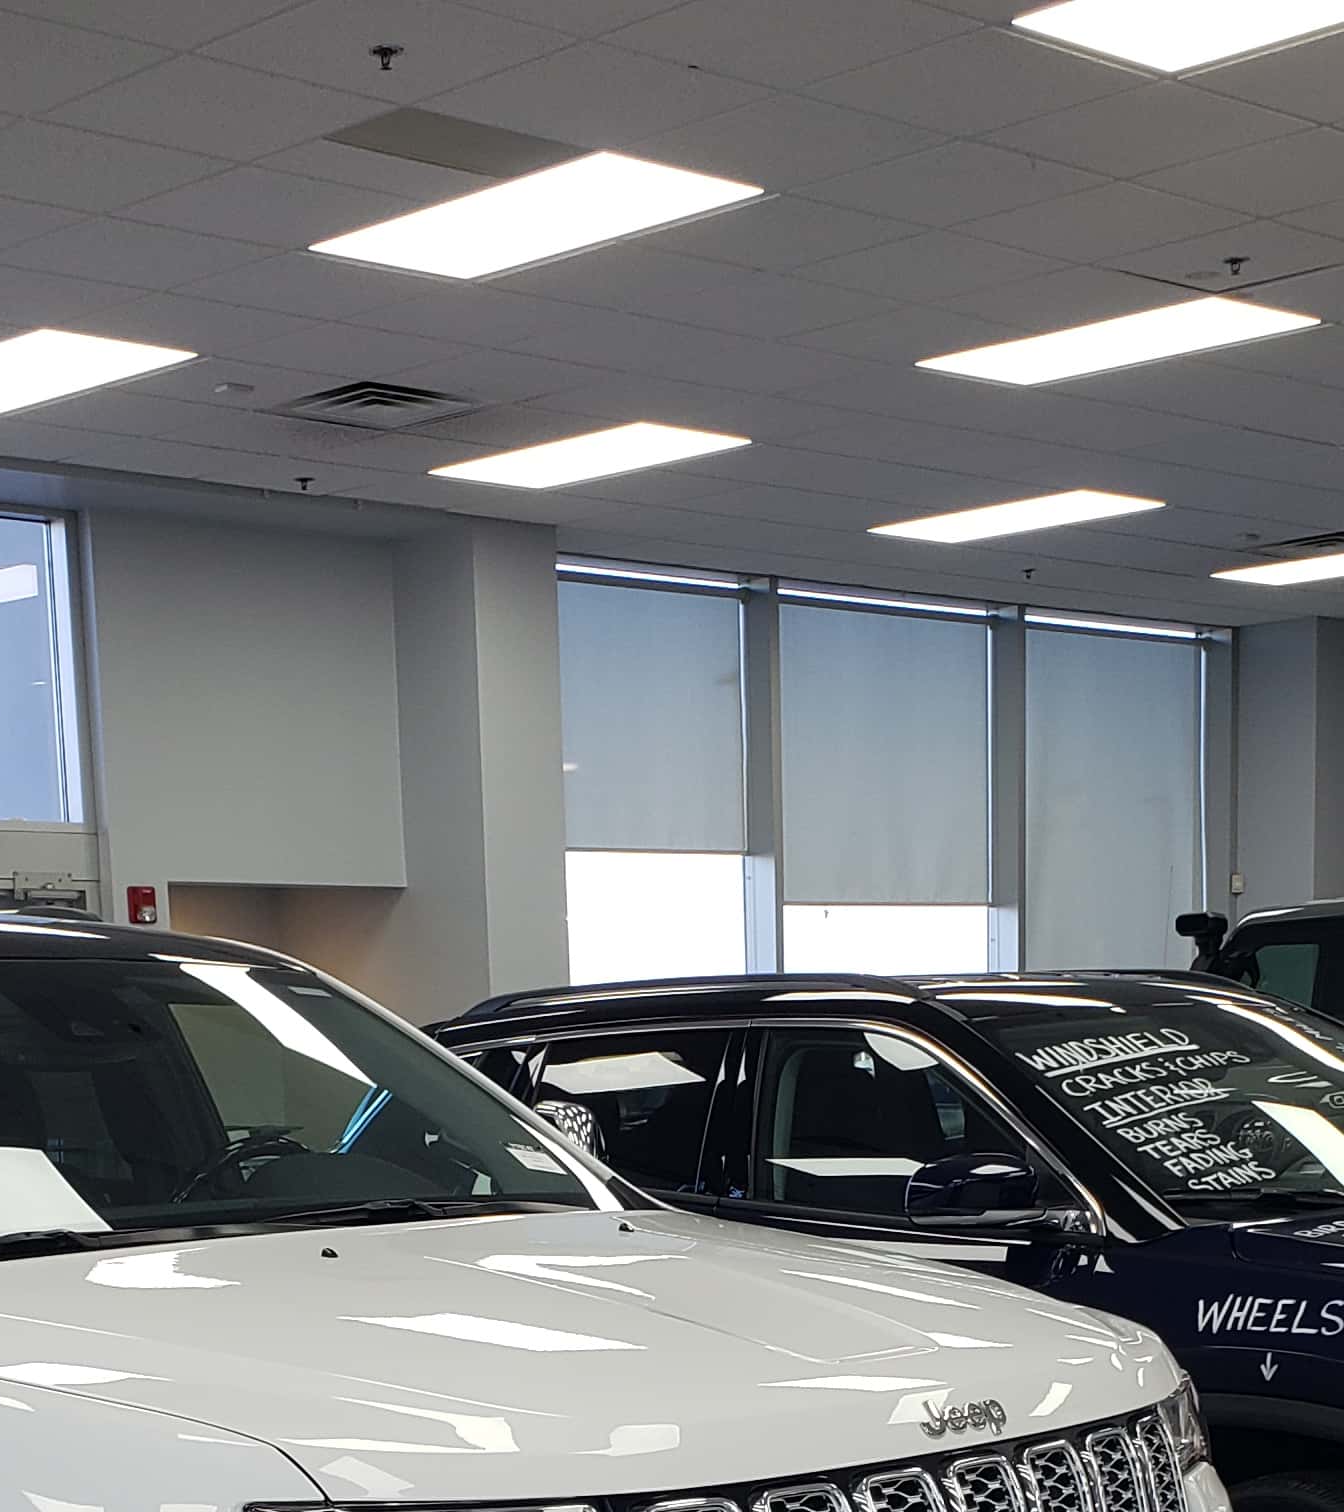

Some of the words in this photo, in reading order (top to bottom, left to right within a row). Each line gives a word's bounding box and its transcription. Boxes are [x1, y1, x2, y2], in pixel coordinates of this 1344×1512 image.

[1014, 1028, 1190, 1072] WINDSHIELD
[1061, 1060, 1168, 1097] CRACKS
[1176, 1050, 1252, 1071] CHIPS
[1083, 1077, 1231, 1126] INTERIOR
[1116, 1111, 1205, 1144] BURNS
[1137, 1126, 1222, 1160] TEARS
[1163, 1141, 1255, 1178] FADING
[1187, 1161, 1277, 1191] STAINS
[920, 1399, 1007, 1439] Jeep
